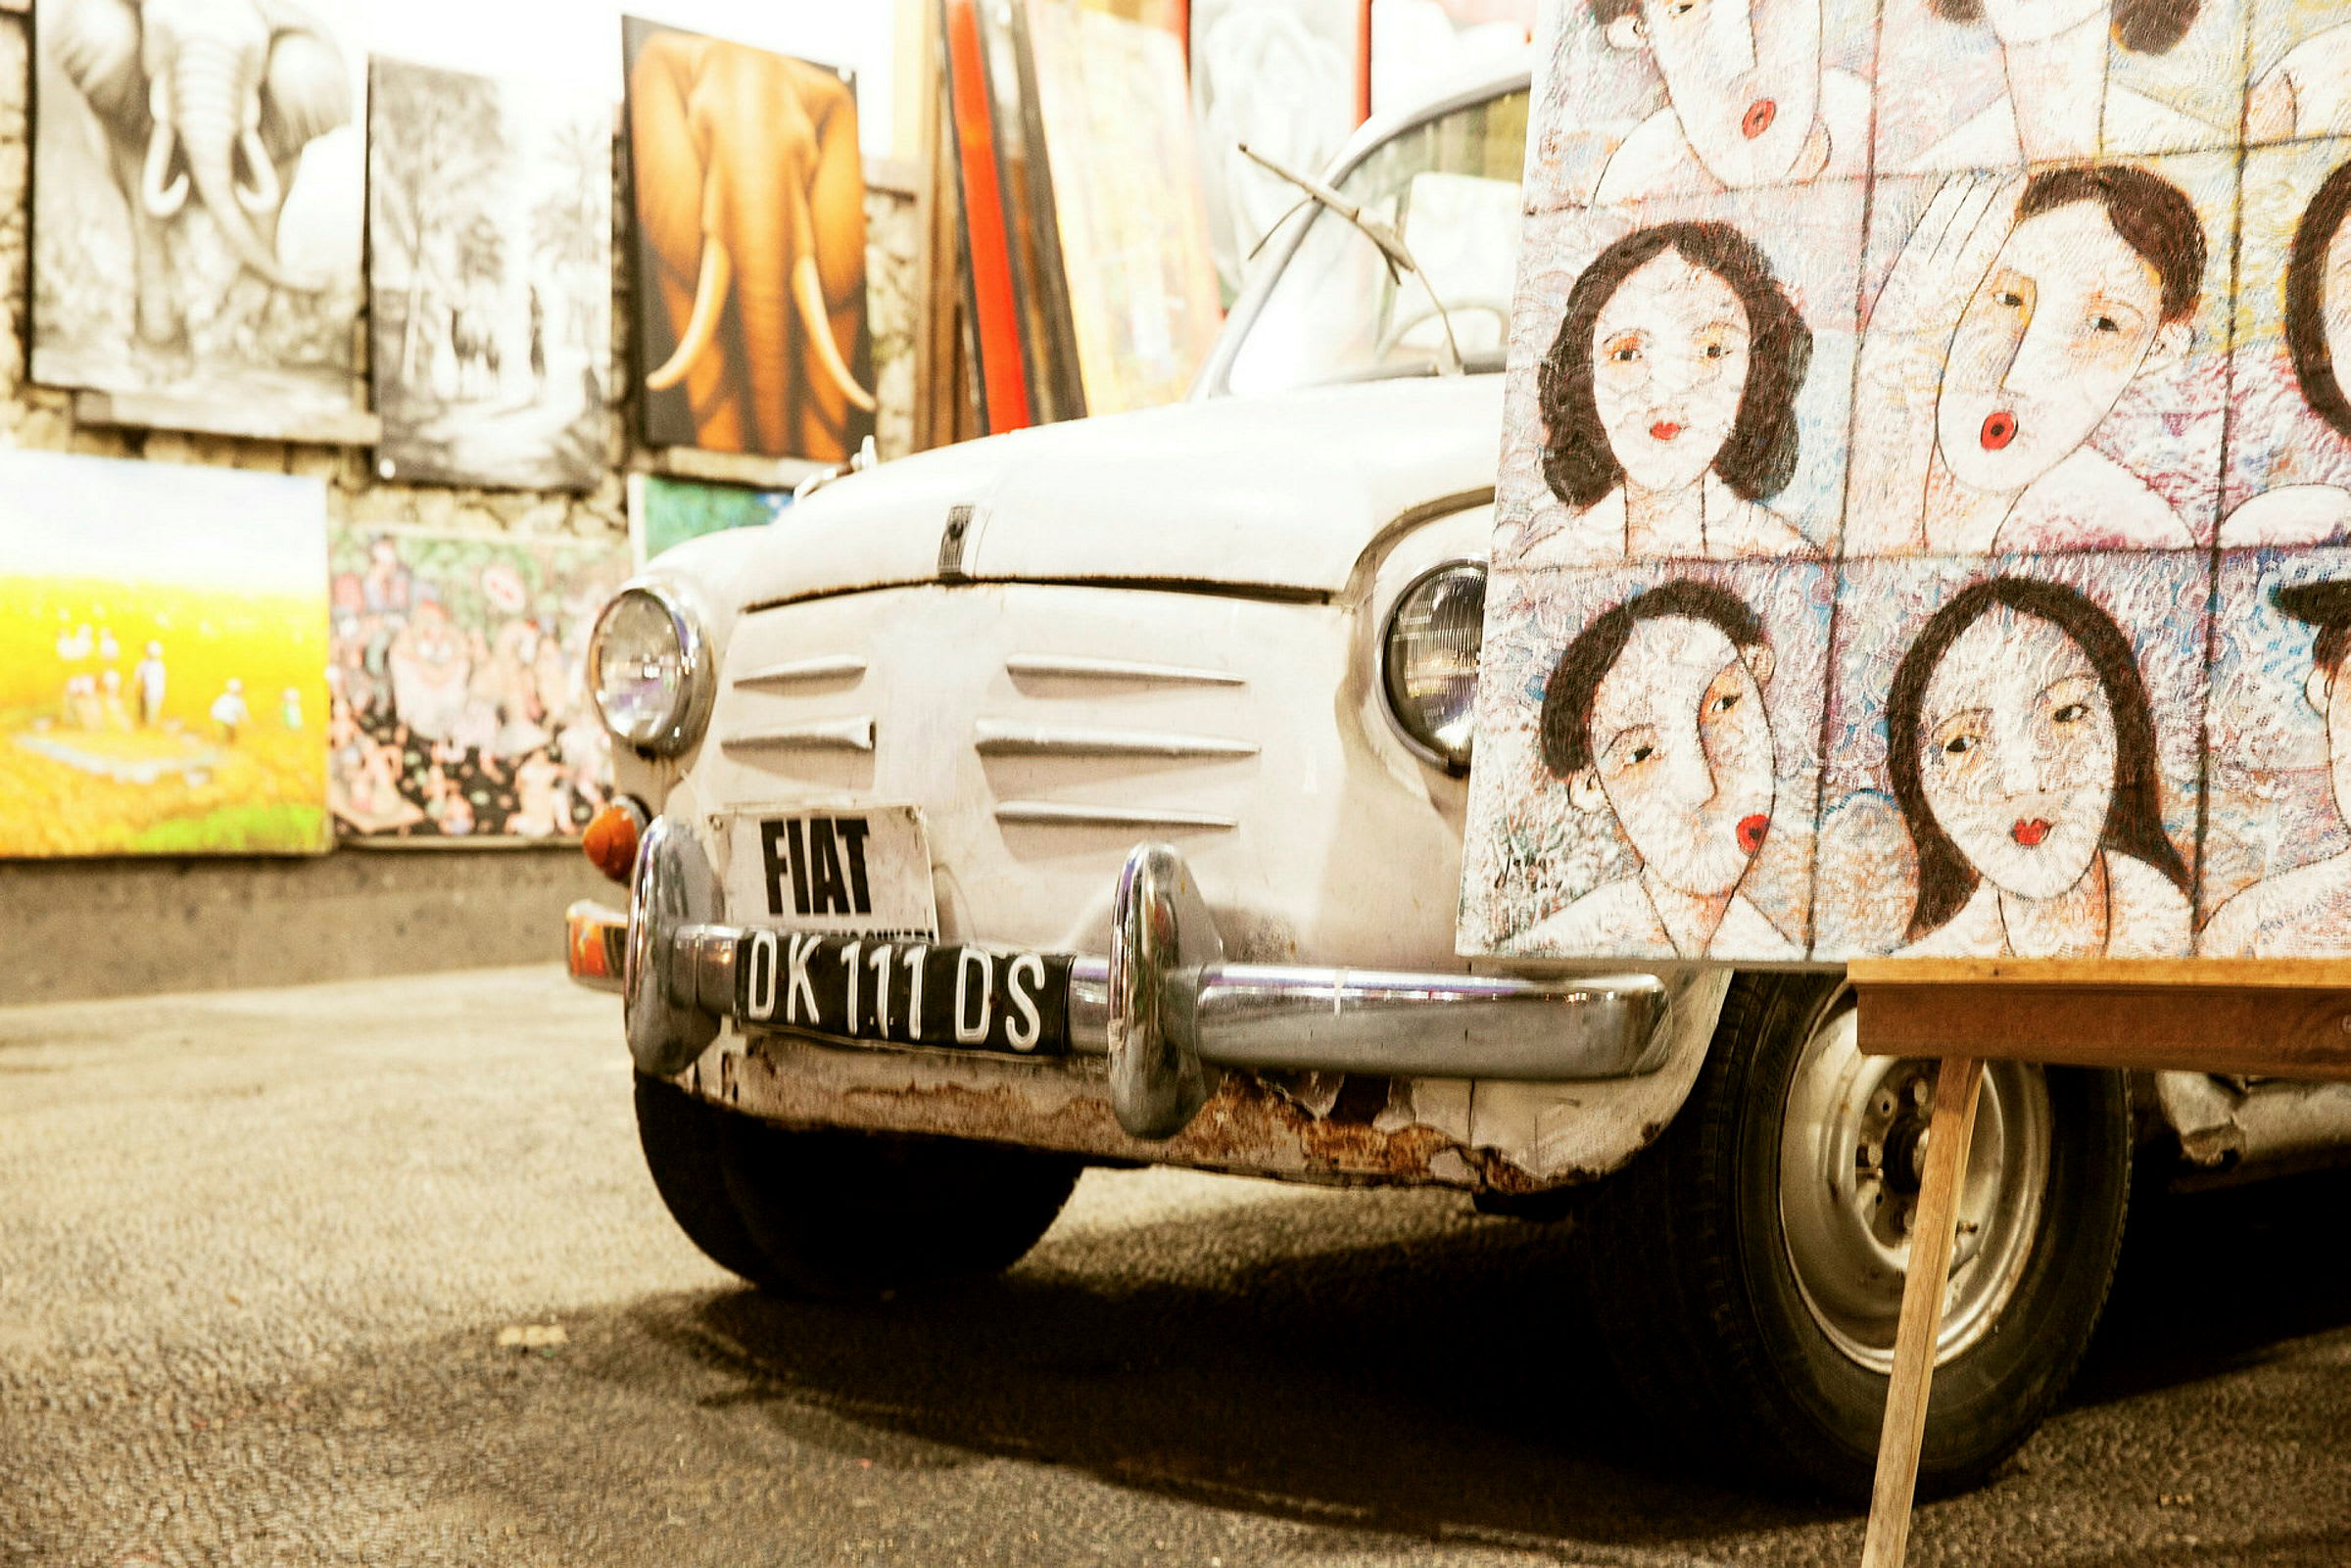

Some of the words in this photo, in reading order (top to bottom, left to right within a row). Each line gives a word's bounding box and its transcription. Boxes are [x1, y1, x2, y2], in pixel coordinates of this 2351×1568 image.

[760, 818, 872, 914] FIAT
[747, 931, 822, 1024] DK
[840, 940, 928, 1041] 111
[954, 947, 1046, 1052] DS
